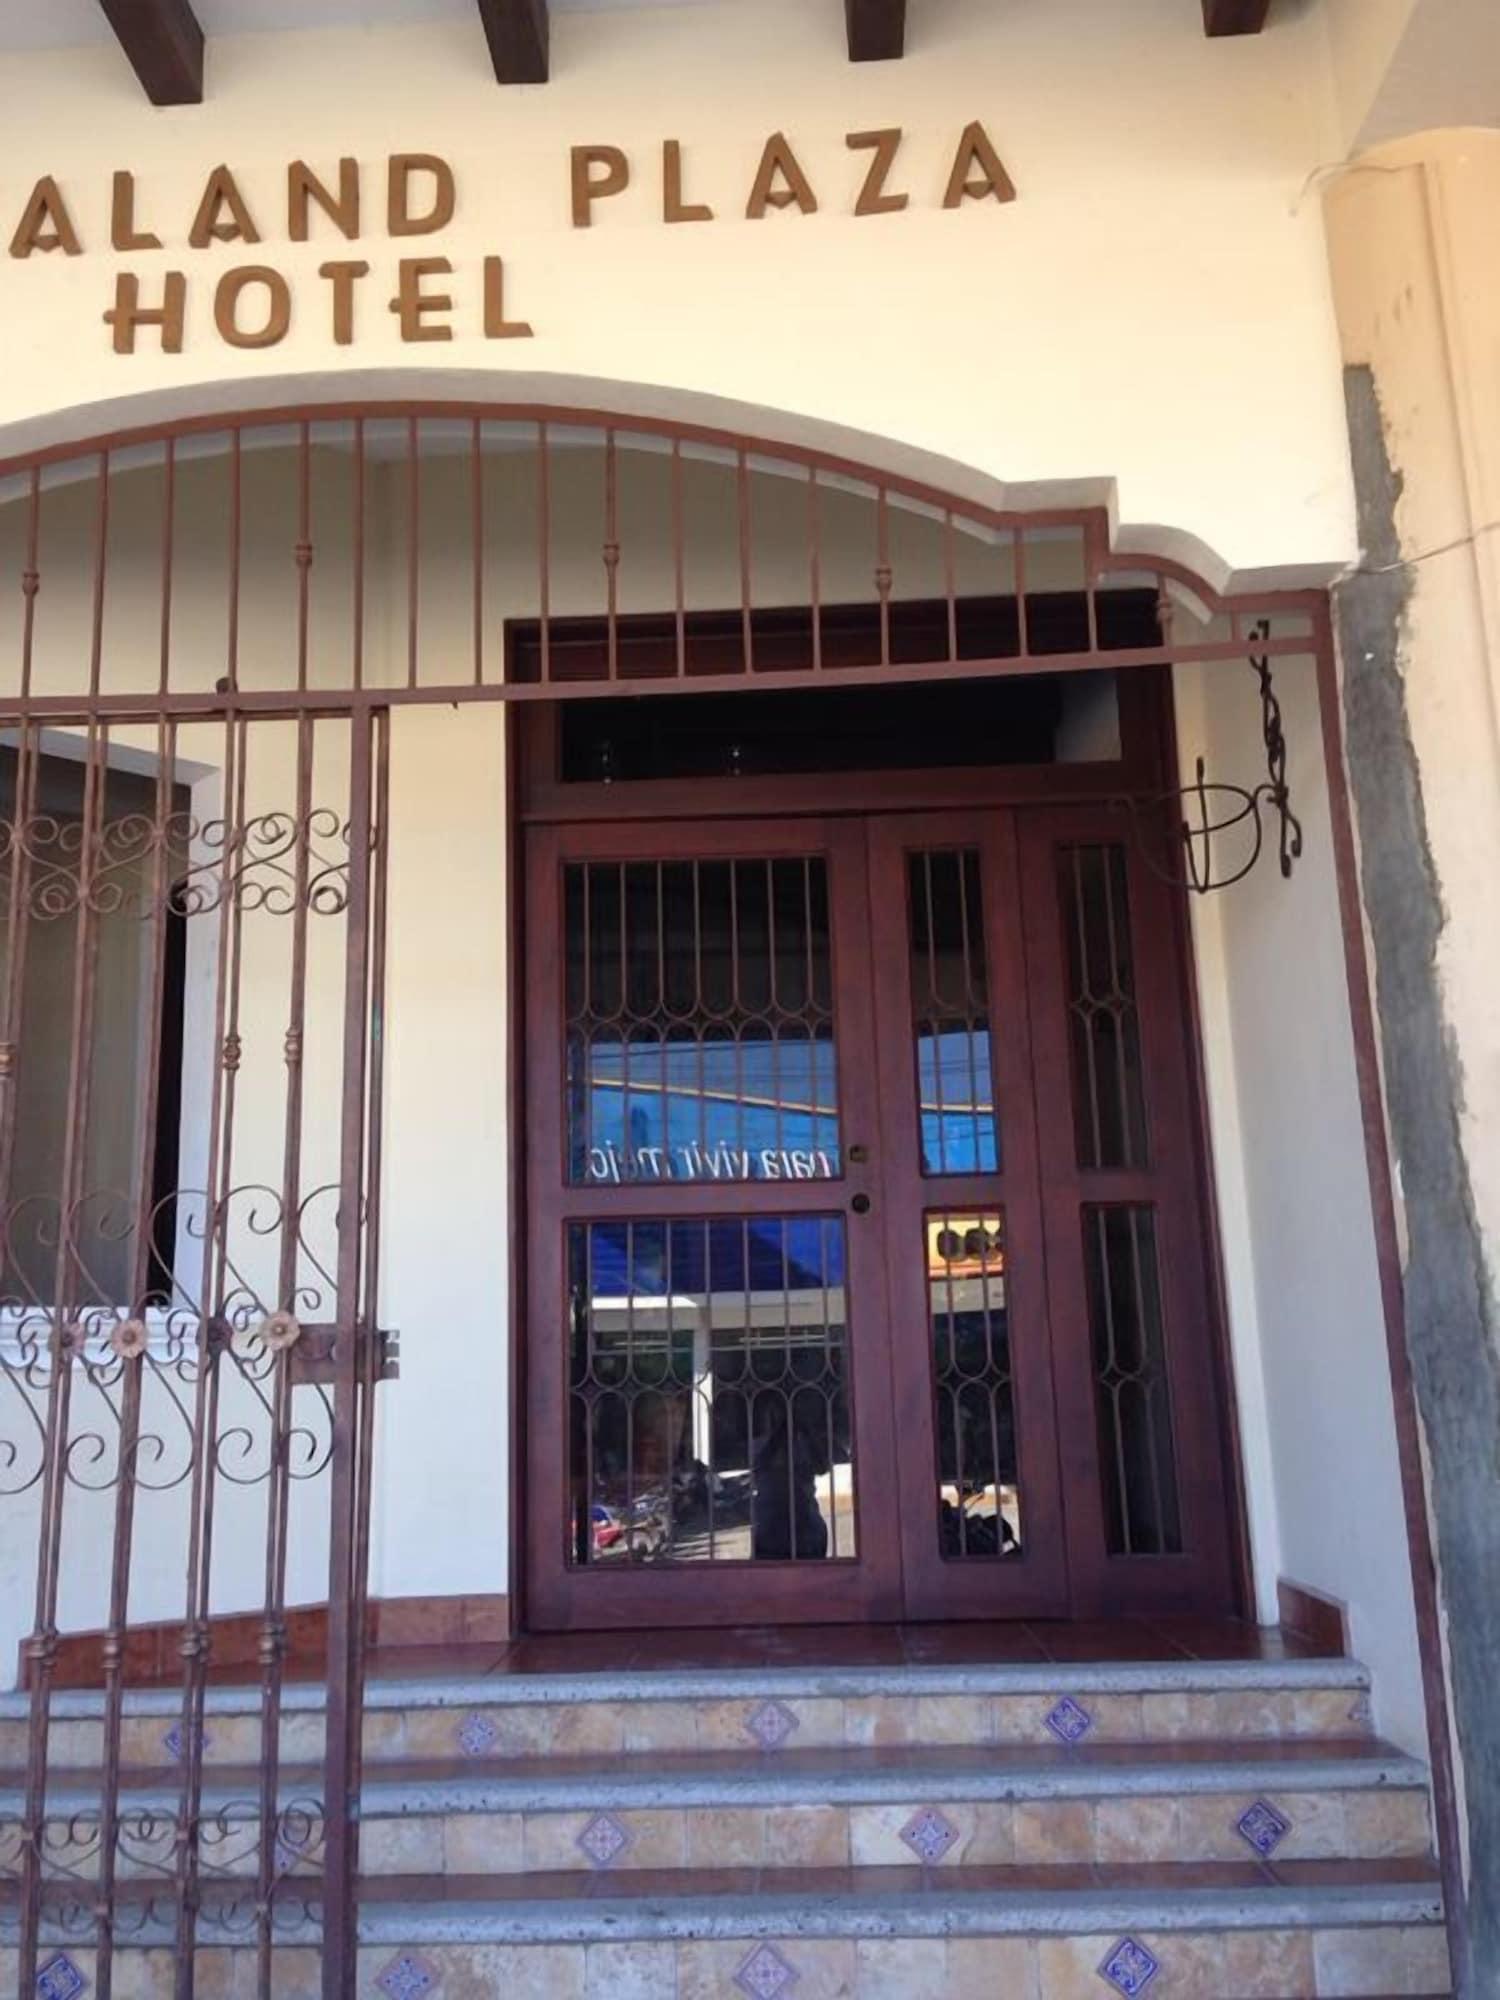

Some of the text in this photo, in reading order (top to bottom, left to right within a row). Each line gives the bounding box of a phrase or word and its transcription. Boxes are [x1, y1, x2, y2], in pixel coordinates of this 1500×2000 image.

[9, 119, 1017, 259] ALAND PLAZA
[103, 255, 534, 355] HOTEL
